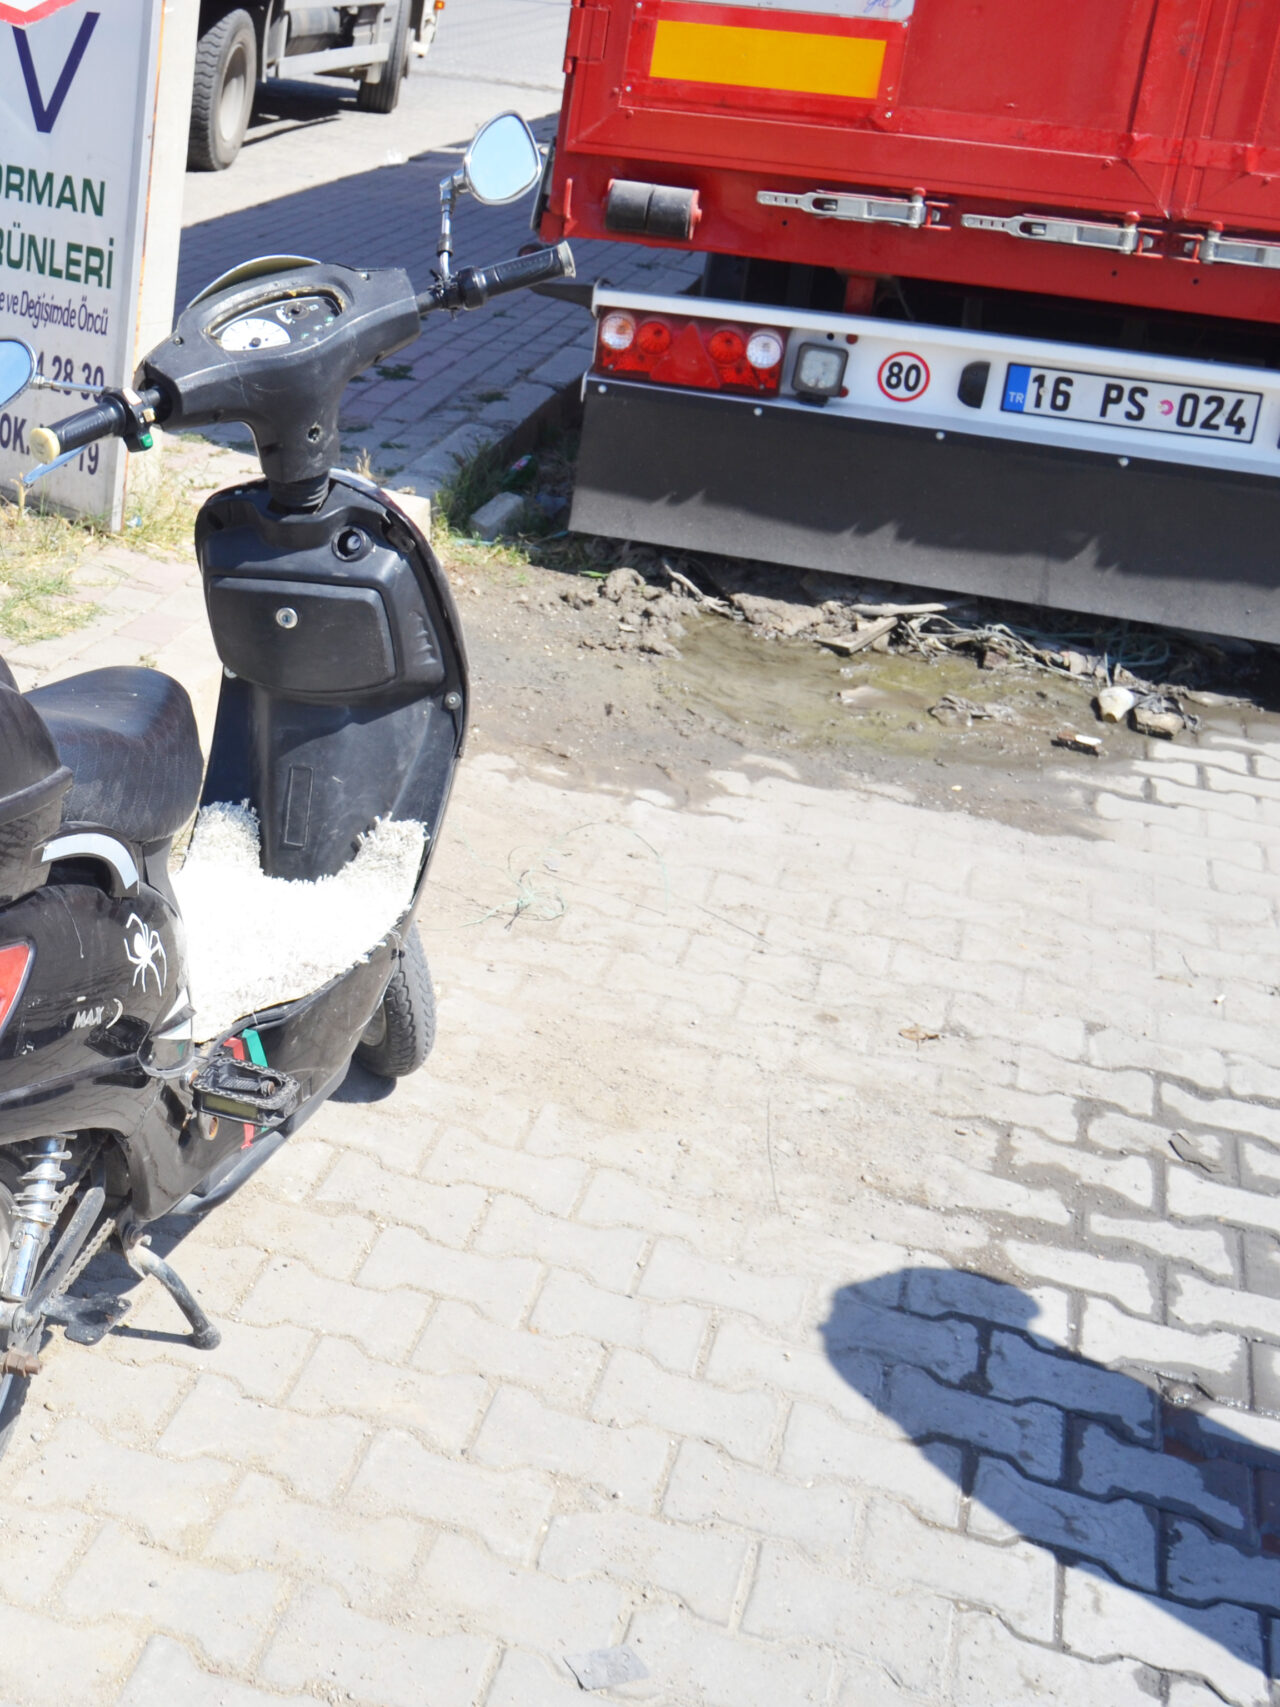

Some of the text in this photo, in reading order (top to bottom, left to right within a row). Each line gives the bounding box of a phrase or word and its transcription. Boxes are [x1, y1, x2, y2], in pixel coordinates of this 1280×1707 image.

[6, 292, 19, 315] ve
[19, 290, 77, 329] Değişimde
[78, 296, 109, 336] Öncü
[51, 355, 74, 396] 28
[885, 361, 922, 392] 80
[1008, 374, 1247, 435] TR 16 PS 024
[72, 1006, 105, 1030] MAX
